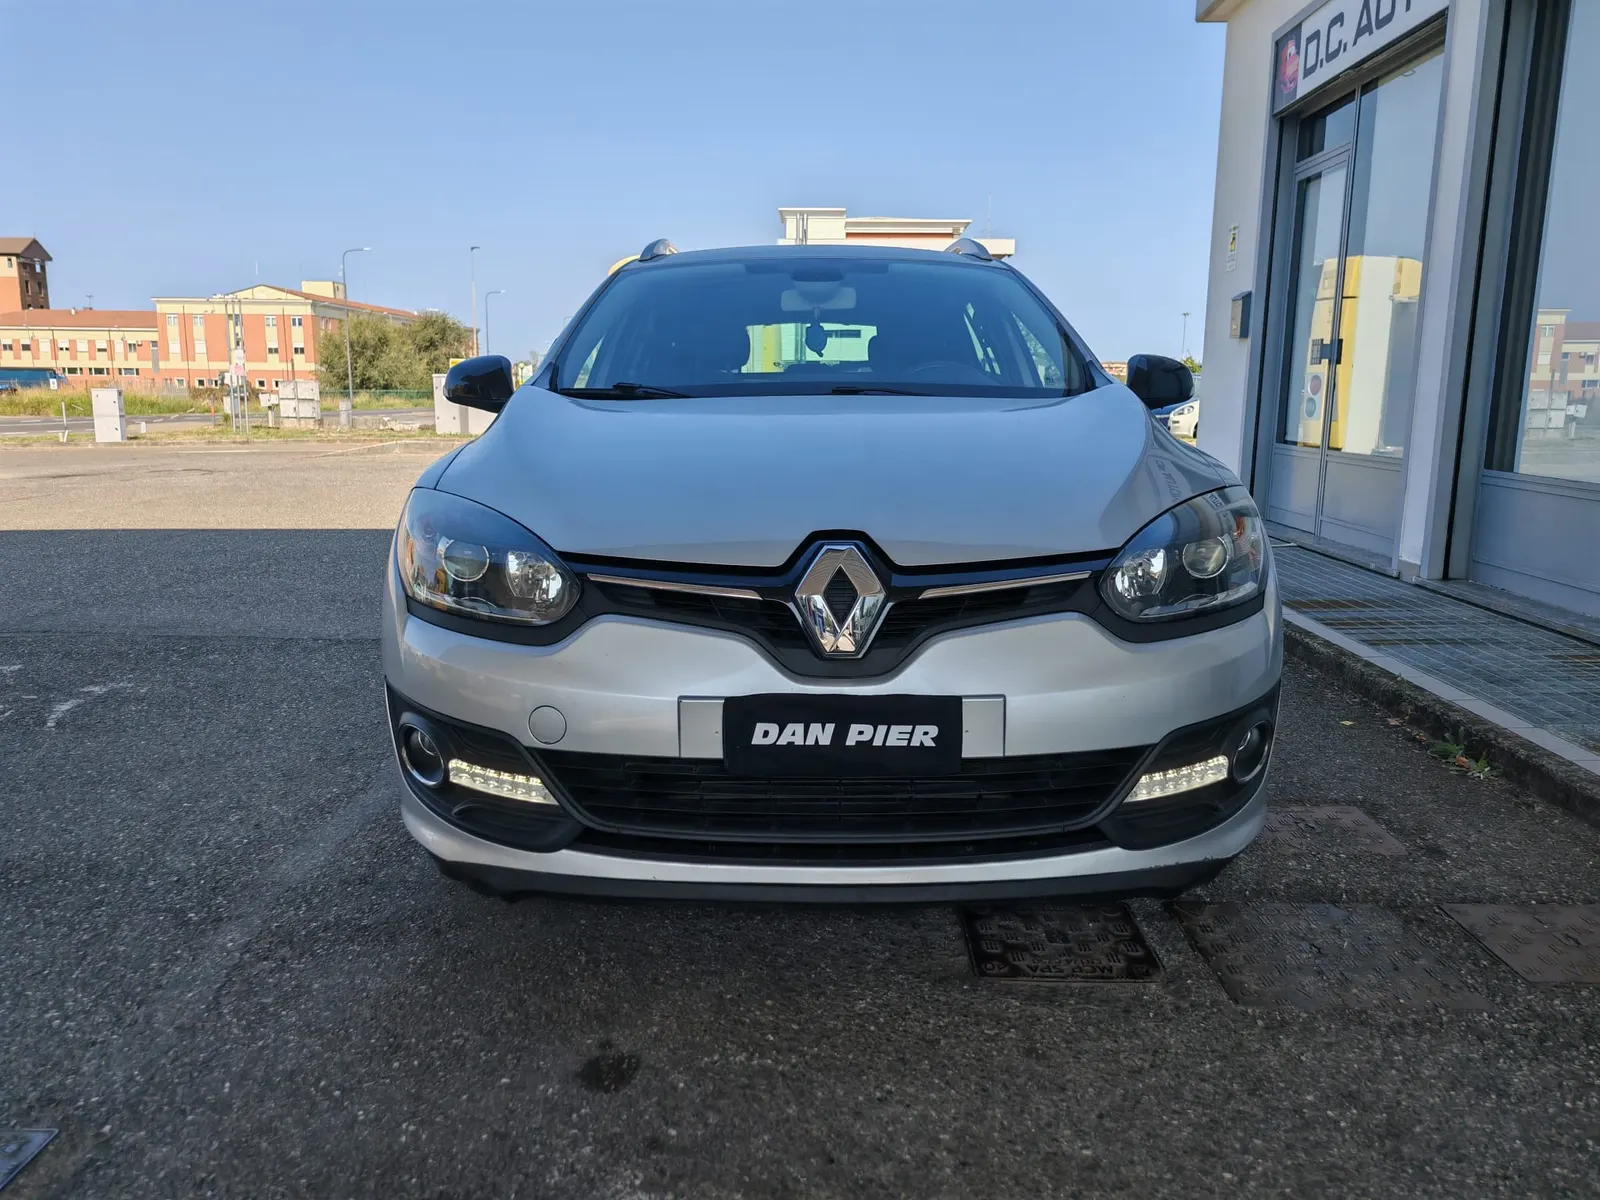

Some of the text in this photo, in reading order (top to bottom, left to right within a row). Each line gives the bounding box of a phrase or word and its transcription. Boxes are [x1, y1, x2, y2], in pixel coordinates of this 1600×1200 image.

[1303, 0, 1411, 79] D.C. AU
[751, 722, 939, 747] DAN PIER
